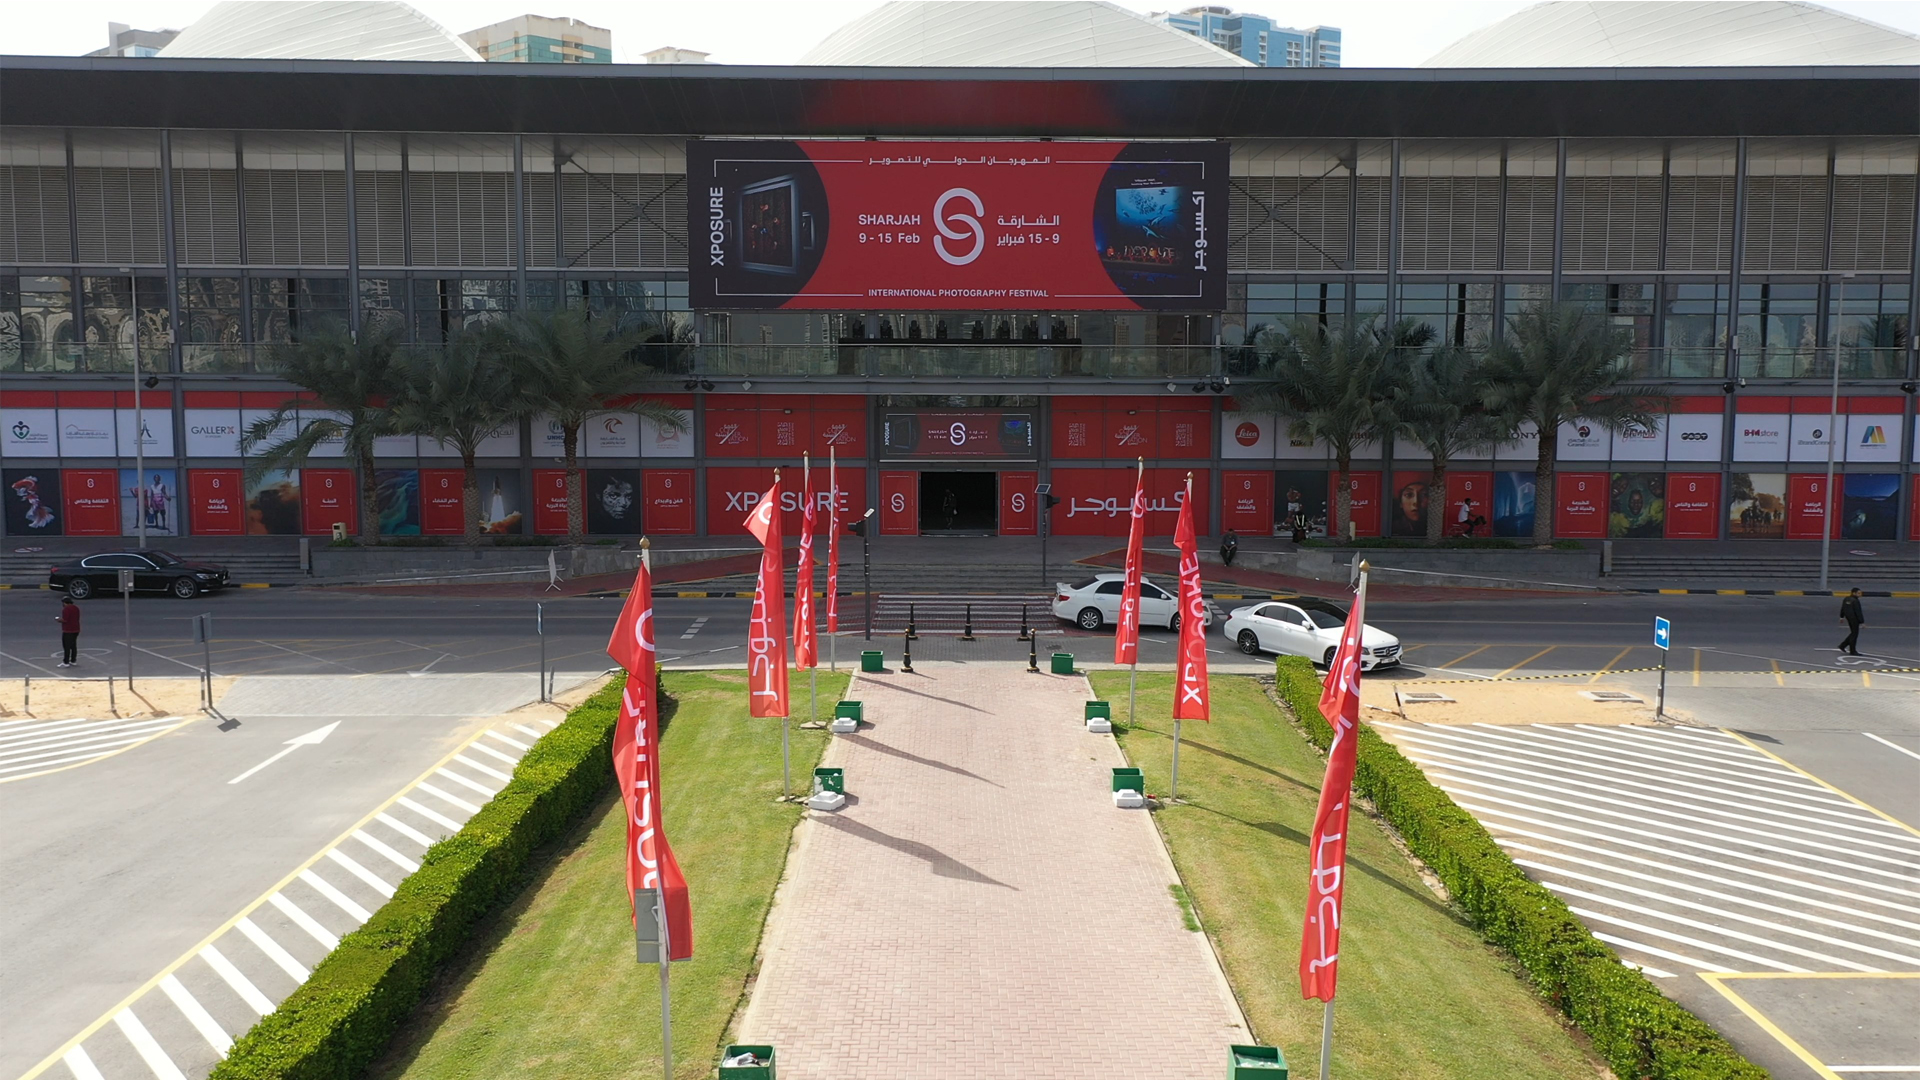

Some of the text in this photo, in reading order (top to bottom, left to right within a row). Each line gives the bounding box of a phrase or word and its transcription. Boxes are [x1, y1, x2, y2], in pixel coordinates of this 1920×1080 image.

[858, 214, 920, 225] SHARJAH
[997, 215, 1060, 229] الشارقة
[709, 187, 724, 266] XPOSURE
[858, 233, 866, 243] 9
[877, 233, 892, 243] 15
[898, 233, 920, 243] Feb
[997, 234, 1025, 246] فبراير
[1028, 233, 1042, 244] 15
[1052, 233, 1060, 244] 9
[868, 289, 1049, 298] INTERNATIONAL PHOTOGRAPHY FESTIVAL
[1237, 428, 1258, 438] Leica
[1511, 432, 1538, 440] ONY
[725, 491, 849, 512] XPSURE
